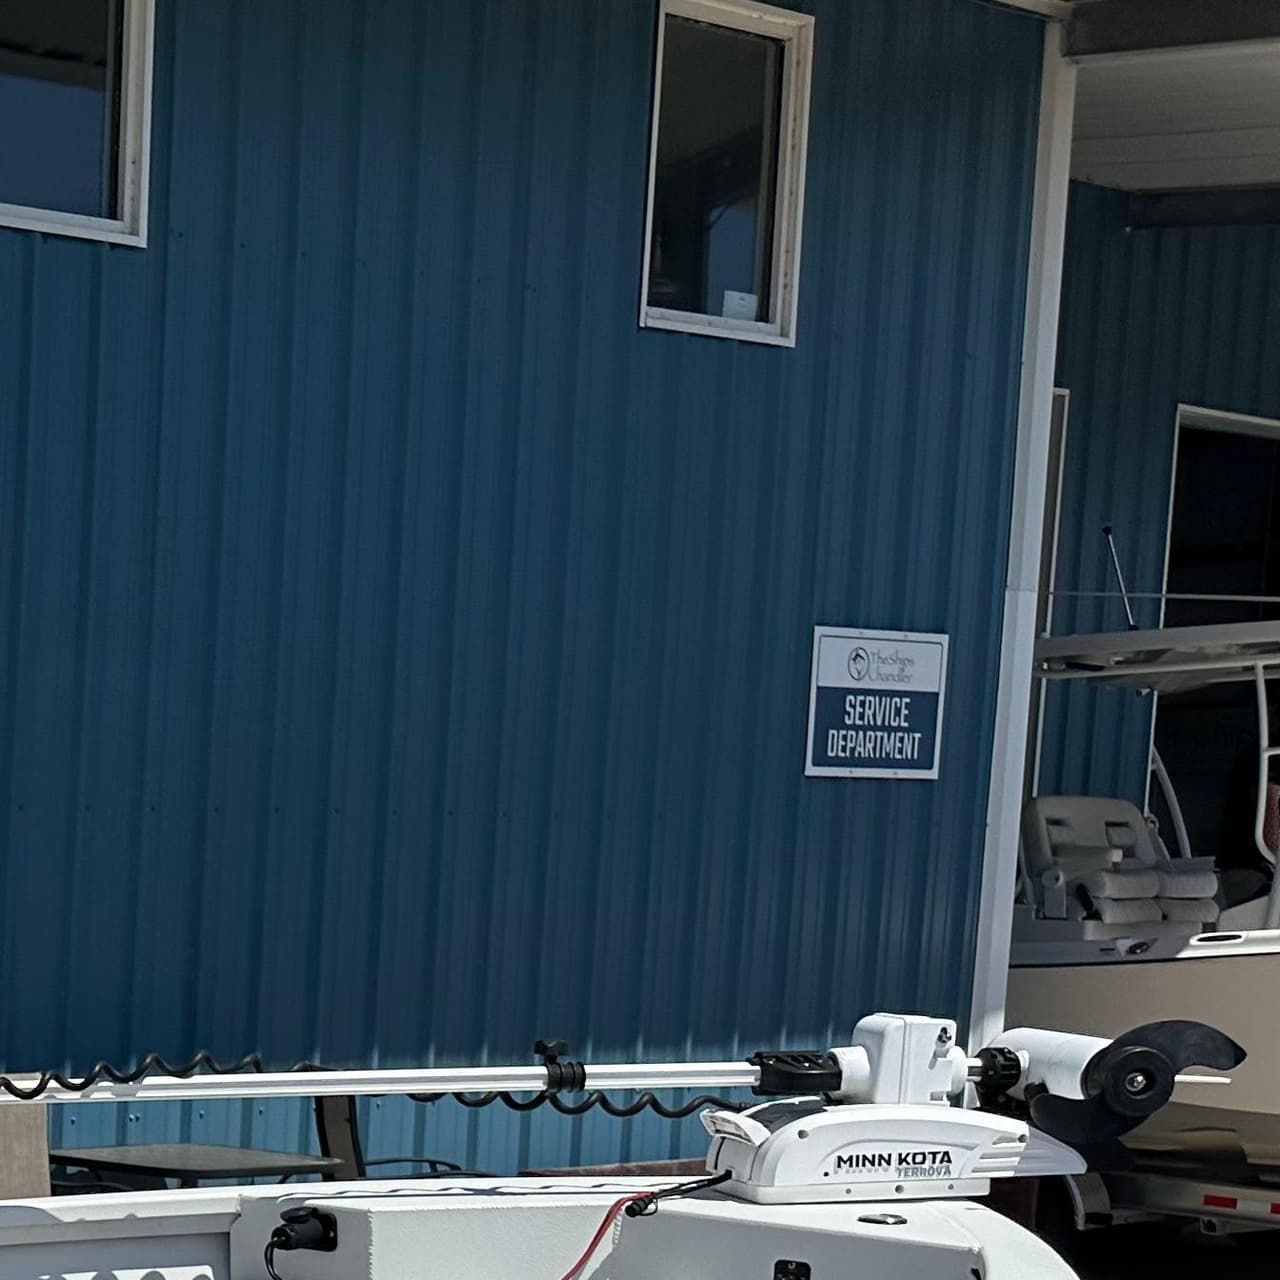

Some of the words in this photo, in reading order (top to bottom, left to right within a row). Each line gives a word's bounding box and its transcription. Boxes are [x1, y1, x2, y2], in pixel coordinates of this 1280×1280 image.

[844, 695, 911, 728] SERVICE
[827, 730, 922, 760] DEPARTMENT
[837, 1153, 892, 1169] MINN
[898, 1151, 953, 1165] KOTA
[896, 1166, 952, 1178] TERROVA
